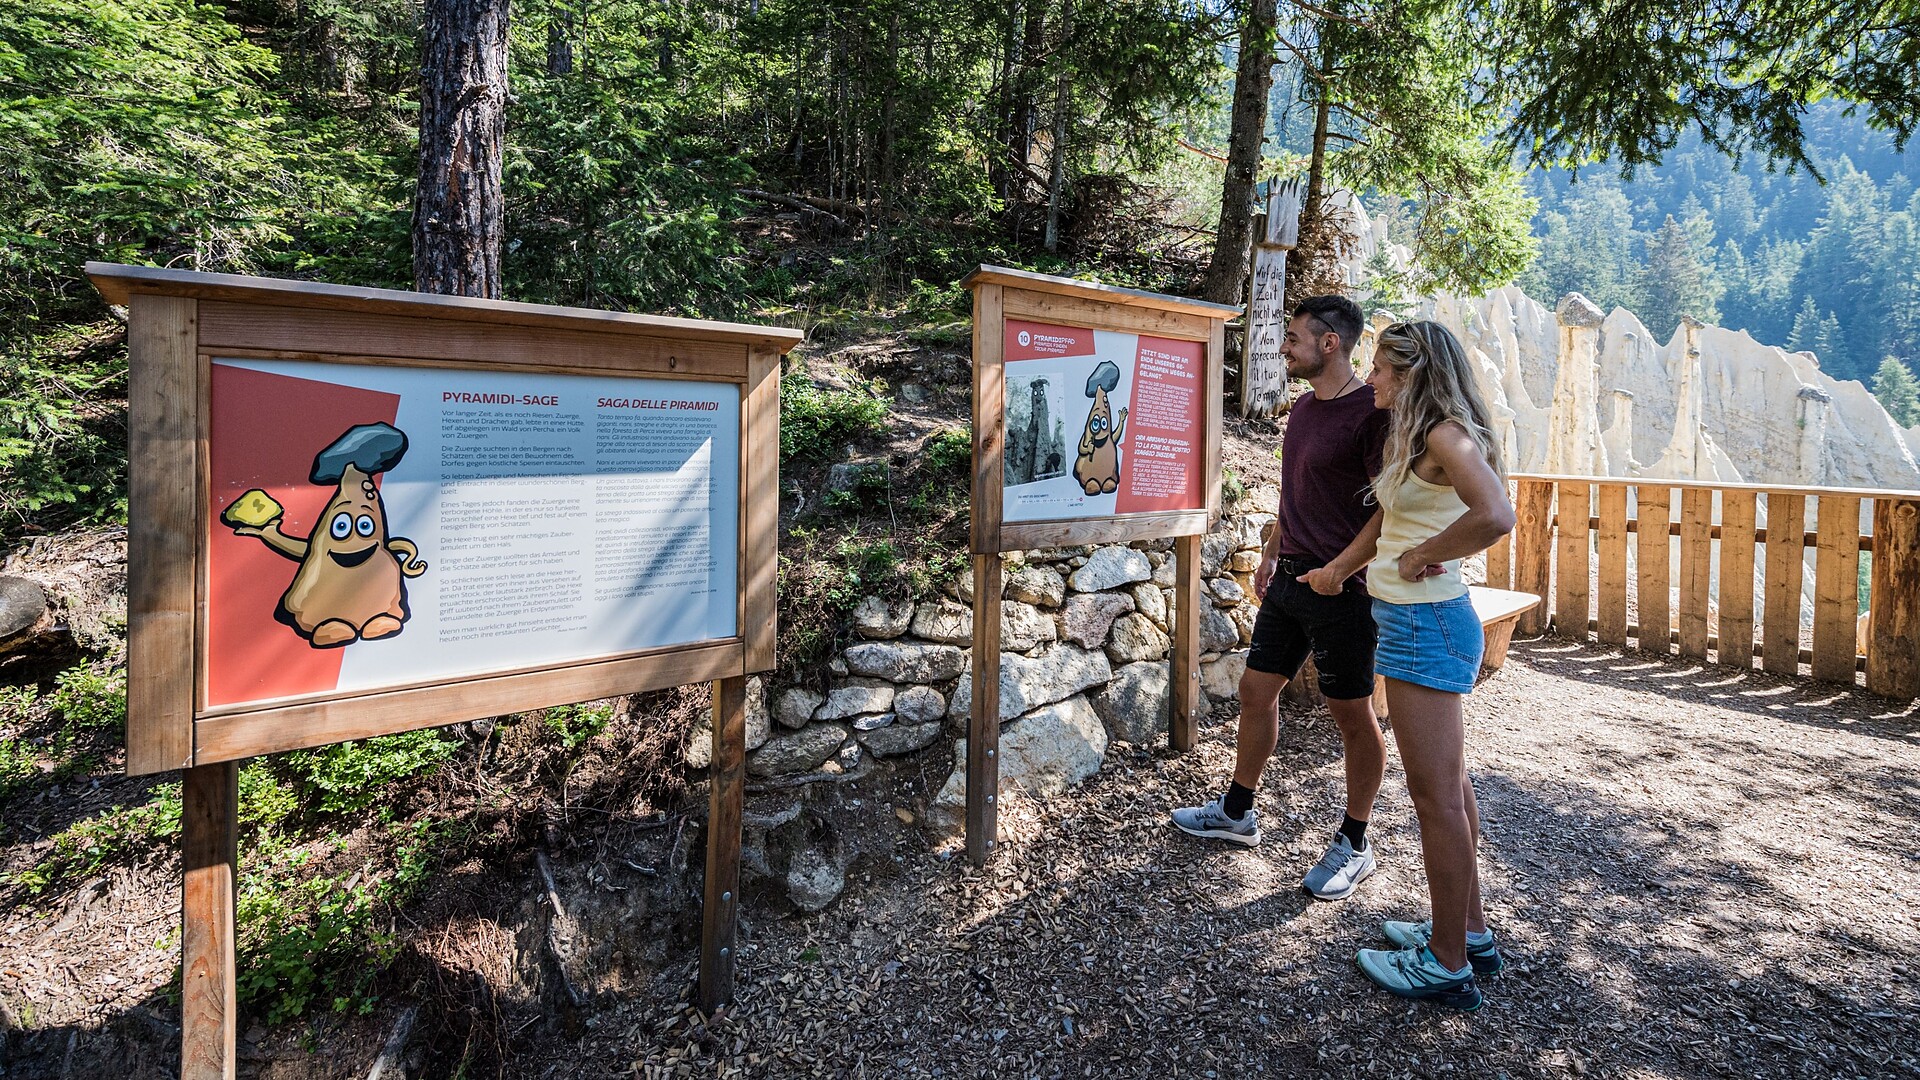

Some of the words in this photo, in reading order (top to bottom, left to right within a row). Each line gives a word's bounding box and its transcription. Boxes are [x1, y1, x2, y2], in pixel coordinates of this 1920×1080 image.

[1256, 264, 1270, 282] Wirf
[1271, 268, 1282, 280] die
[1256, 283, 1278, 300] Zeit
[1252, 304, 1270, 319] nicht
[1272, 310, 1283, 324] weg
[1034, 334, 1076, 345] PYRAMIDIPFAD
[1260, 332, 1275, 346] Non
[1155, 359, 1175, 368] UNSERES
[1252, 351, 1282, 366] sprecare
[1140, 363, 1168, 374] MEINSAMEN
[1170, 369, 1185, 377] WEGES
[1140, 370, 1162, 379] GELANGT.
[1253, 368, 1259, 381] il
[1264, 367, 1278, 380] tuo
[1252, 381, 1285, 402] Tempo!
[597, 398, 630, 408] SAGA
[632, 399, 668, 410] DELLE
[669, 400, 719, 411] PIRAMIDI
[455, 409, 476, 418] langer
[454, 424, 489, 433] abgelegen
[454, 444, 481, 453] Zwerge
[532, 445, 555, 453] Bergen
[519, 459, 544, 468] Speisen
[462, 500, 480, 509] Tages
[482, 499, 504, 508] jedoch
[541, 498, 565, 507] Zwerge
[440, 507, 480, 517] verborgene
[440, 522, 467, 532] riesigen
[469, 521, 485, 530] Berg
[439, 626, 460, 635] Wenn
[478, 622, 504, 631] wirklich
[506, 620, 516, 630] gut
[518, 618, 543, 627] hinsieht
[544, 615, 571, 624] entdeckt
[439, 634, 459, 643] heute
[461, 632, 479, 641] noch
[480, 630, 493, 638] ihre
[494, 626, 530, 637] erstaunten
